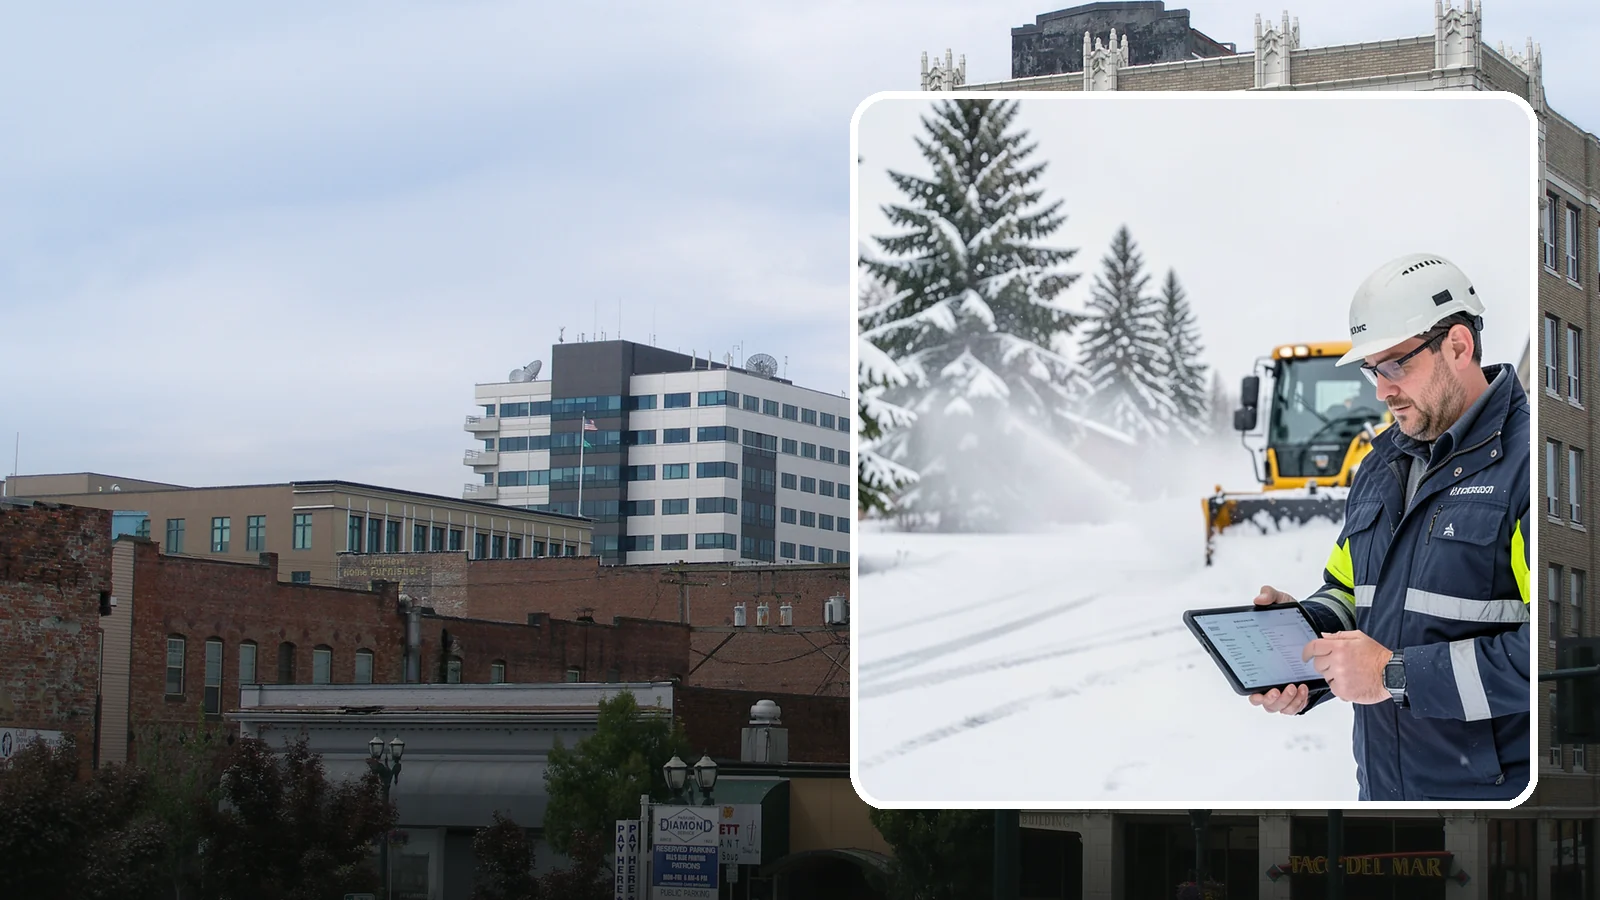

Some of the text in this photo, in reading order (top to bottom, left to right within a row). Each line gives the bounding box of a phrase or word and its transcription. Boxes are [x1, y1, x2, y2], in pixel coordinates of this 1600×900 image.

[660, 818, 713, 833] DIAMOND
[1022, 815, 1069, 827] BUILDING
[655, 845, 716, 854] RESERVED PARKING
[616, 824, 625, 893] PAY HERE
[627, 824, 637, 893] PAY HERE
[721, 851, 739, 862] Soup
[671, 862, 701, 870] PATRONS
[1289, 855, 1442, 877] TAC DEL MAR
[660, 888, 710, 898] PUBLIC PARKING
